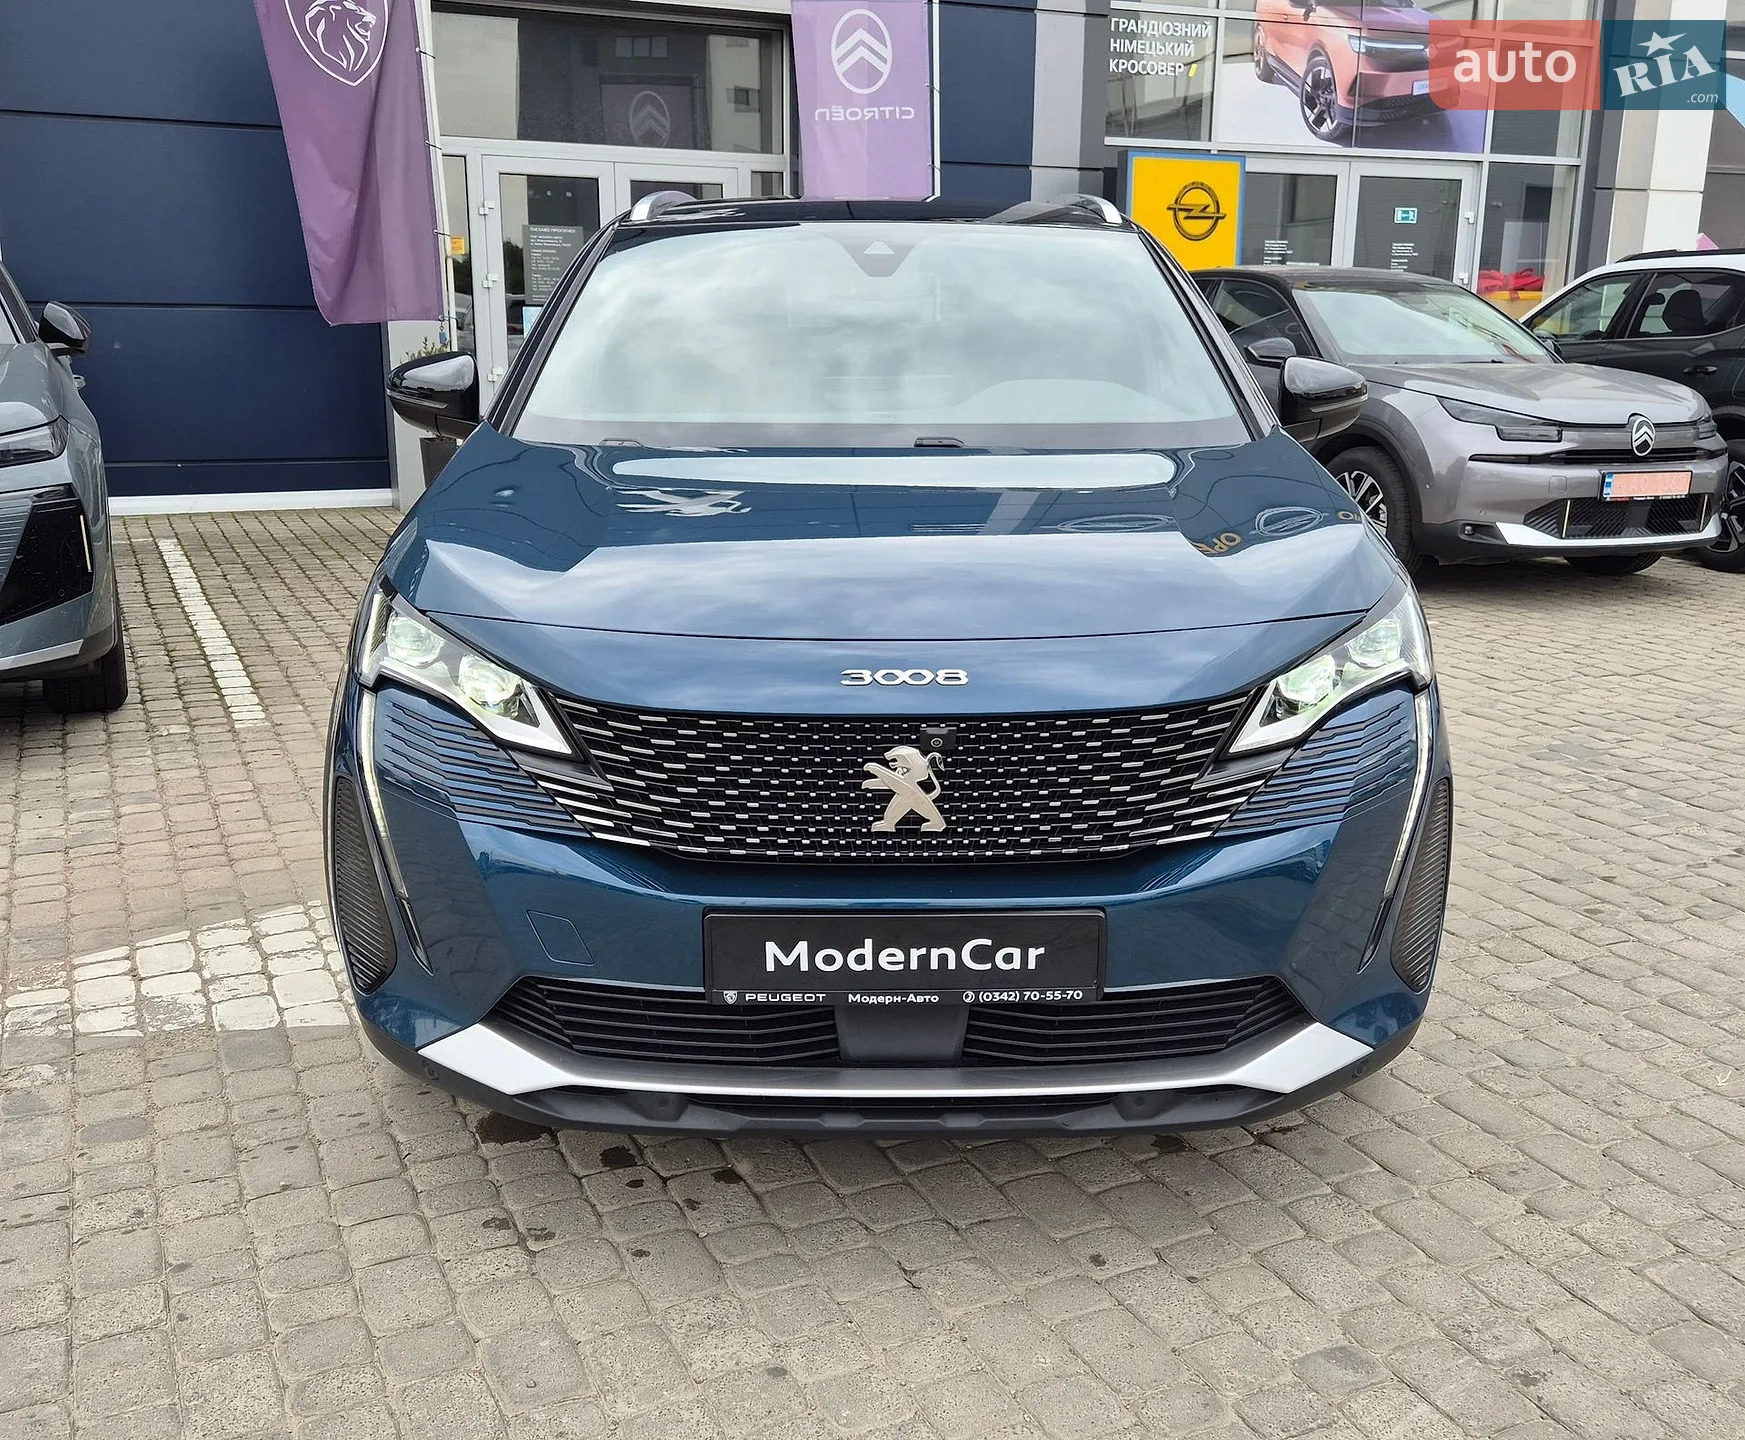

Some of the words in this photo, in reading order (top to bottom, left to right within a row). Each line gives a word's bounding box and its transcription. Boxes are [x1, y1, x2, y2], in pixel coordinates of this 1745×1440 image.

[1110, 17, 1212, 38] ГРАНДІОЗНИЙ
[1110, 38, 1195, 57] НІМЕЦЬКИЙ
[1109, 58, 1184, 76] КРОСОВЕР
[840, 669, 969, 686] 3008
[765, 938, 1046, 972] ModernCar
[745, 993, 827, 1002] PEUGEOT
[848, 993, 940, 1004] Модерн-Авто
[978, 991, 1020, 1003] (0342)
[1023, 990, 1083, 1001] 70-55-70
